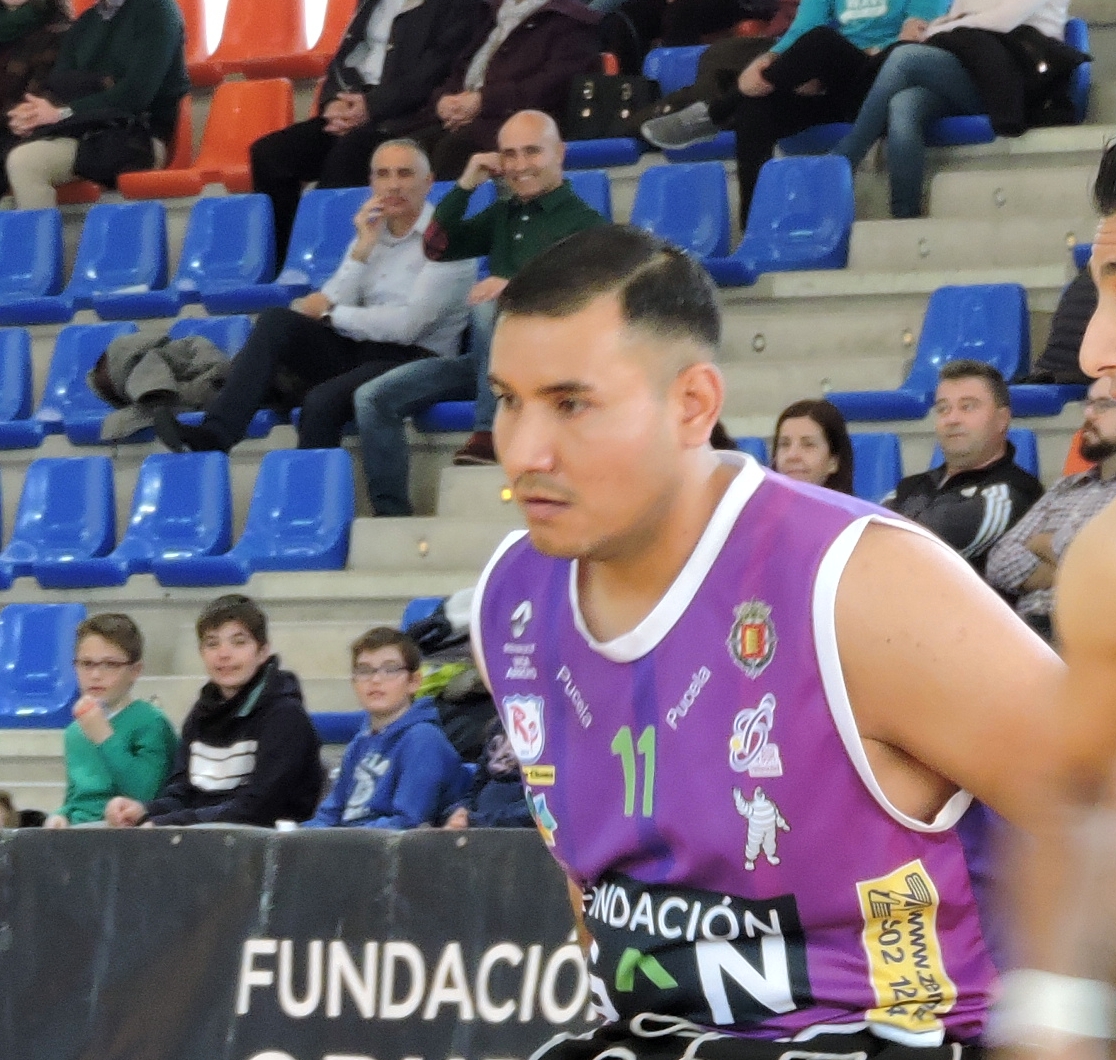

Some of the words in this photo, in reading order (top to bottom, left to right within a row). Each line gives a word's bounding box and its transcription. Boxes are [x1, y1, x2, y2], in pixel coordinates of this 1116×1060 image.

[555, 664, 594, 730] Pucela
[666, 665, 712, 731] Pucela
[610, 724, 657, 818] 11
[235, 926, 598, 1025] FUNDACIÓ
